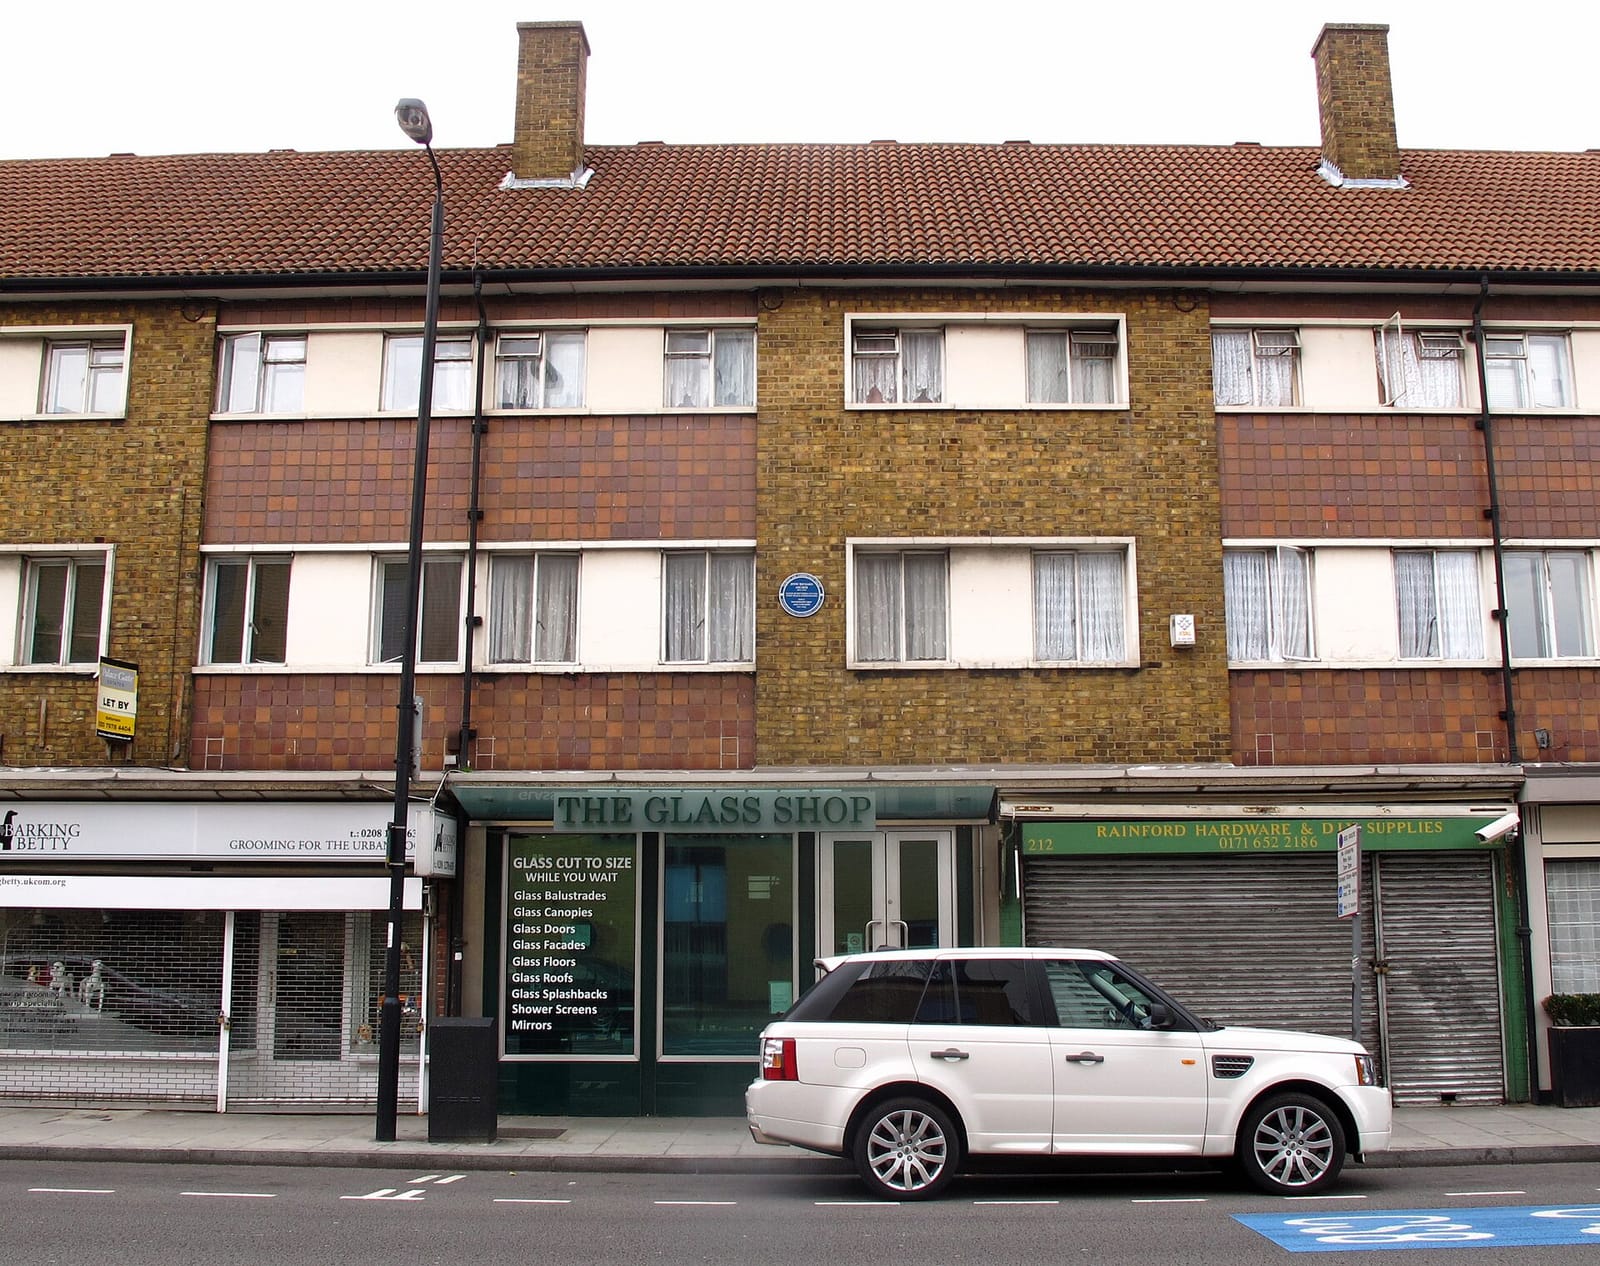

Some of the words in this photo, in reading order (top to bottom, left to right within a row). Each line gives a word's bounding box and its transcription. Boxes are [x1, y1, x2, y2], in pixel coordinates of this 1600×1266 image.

[103, 697, 115, 708] LET
[118, 701, 129, 710] BY
[558, 796, 633, 825] THE
[643, 796, 762, 825] GLASS
[773, 796, 872, 824] SHOP
[4, 824, 81, 837] BARKING
[361, 829, 382, 838] 0208
[1096, 824, 1187, 837] RAINFORD
[1196, 823, 1291, 836] HARDWARE
[1301, 822, 1313, 835] &
[1367, 821, 1443, 834] SUPPLIES
[17, 837, 71, 850] BETTY
[229, 840, 296, 850] GROOMING
[298, 840, 321, 850] FOR
[325, 840, 350, 850] THE
[1029, 838, 1054, 850] 212
[1219, 837, 1249, 849] 0171
[1253, 836, 1279, 849] 652
[1284, 835, 1318, 848] 2186
[513, 857, 553, 869] GLASS
[556, 857, 582, 869] CUT
[584, 857, 602, 869] TO
[605, 857, 632, 869] SIZE
[0, 877, 66, 887] betty.ukcom.org
[525, 872, 560, 882] WHILE
[563, 872, 586, 882] YOU
[589, 872, 618, 882] WAIT
[514, 890, 542, 901] Glass
[544, 890, 607, 901] Balustrades
[513, 907, 541, 917] Glass
[544, 907, 593, 919] Canopies
[513, 924, 541, 934] Glass
[544, 924, 576, 934] Doors
[513, 940, 541, 950] Glass
[543, 940, 586, 950] Facades
[512, 956, 541, 967] Glass
[543, 956, 576, 967] Floors
[512, 973, 540, 983] Glass
[543, 973, 574, 983] Roofs
[511, 989, 540, 999] Glass
[542, 989, 608, 1001] Splashbacks
[511, 1004, 553, 1014] Shower
[555, 1004, 598, 1014] Screens
[511, 1020, 552, 1030] Mirrors
